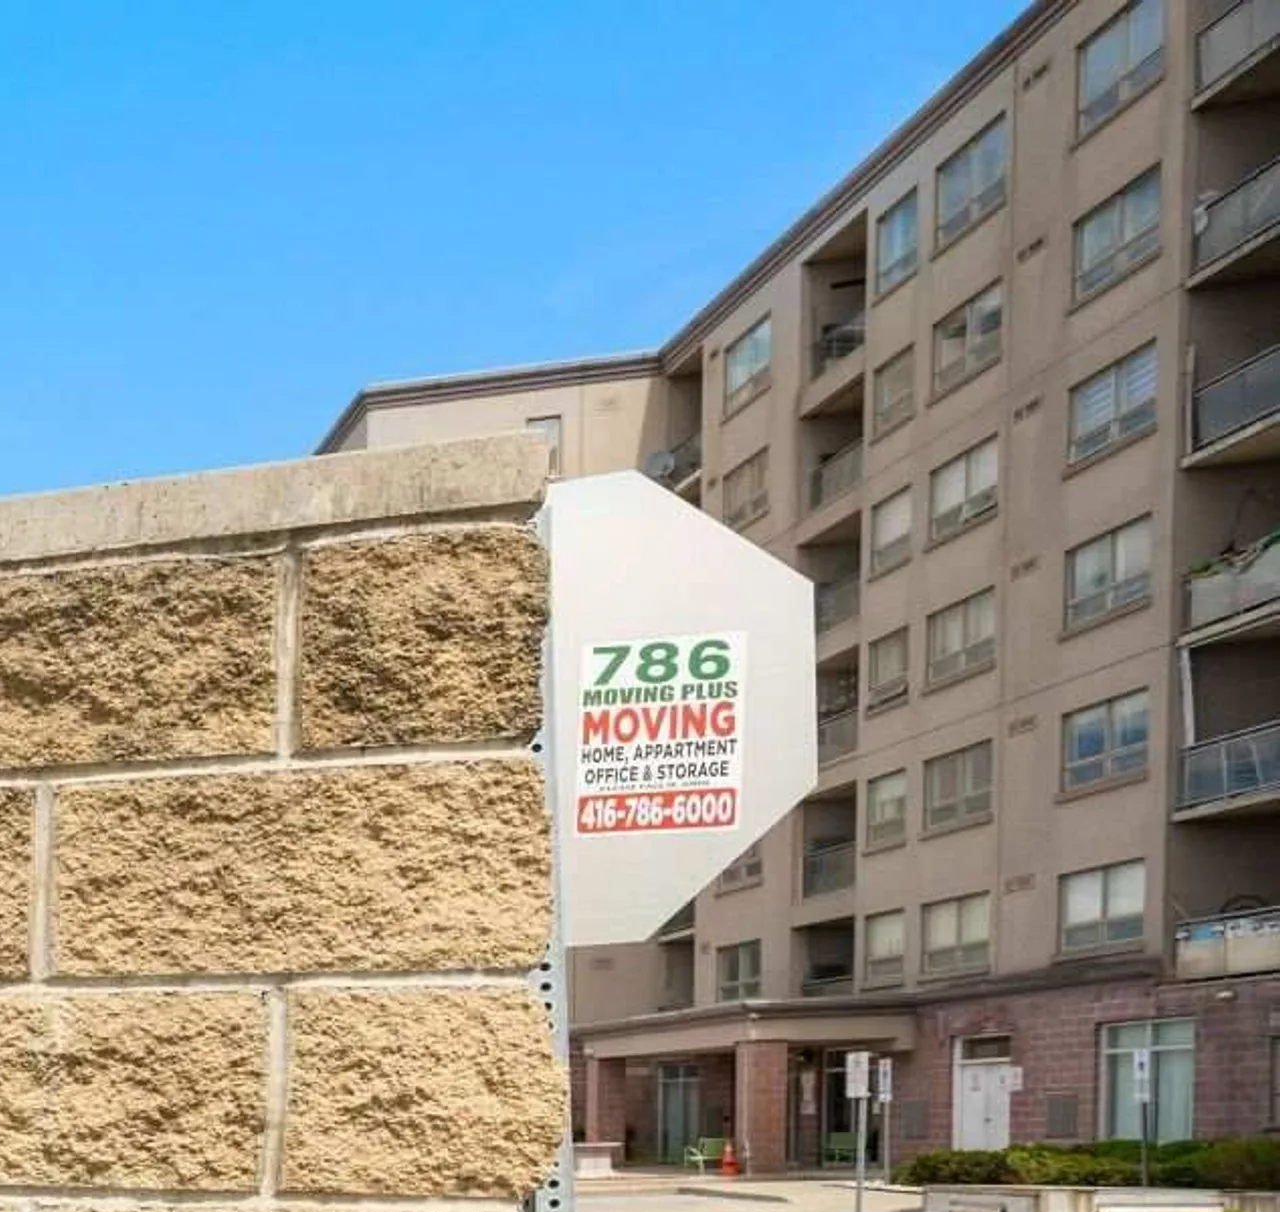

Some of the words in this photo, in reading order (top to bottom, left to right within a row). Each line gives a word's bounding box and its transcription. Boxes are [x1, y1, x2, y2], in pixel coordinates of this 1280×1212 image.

[593, 639, 731, 686] 786
[582, 684, 675, 707] MOVING
[680, 681, 738, 701] PLUS
[581, 700, 736, 745] MOVING
[581, 746, 629, 765] HOME,
[633, 738, 737, 761] APPARTMENT
[584, 766, 638, 784] OFFICE
[643, 765, 653, 781] &
[657, 760, 730, 780] STORAGE
[580, 792, 732, 829] 416-786-6000
